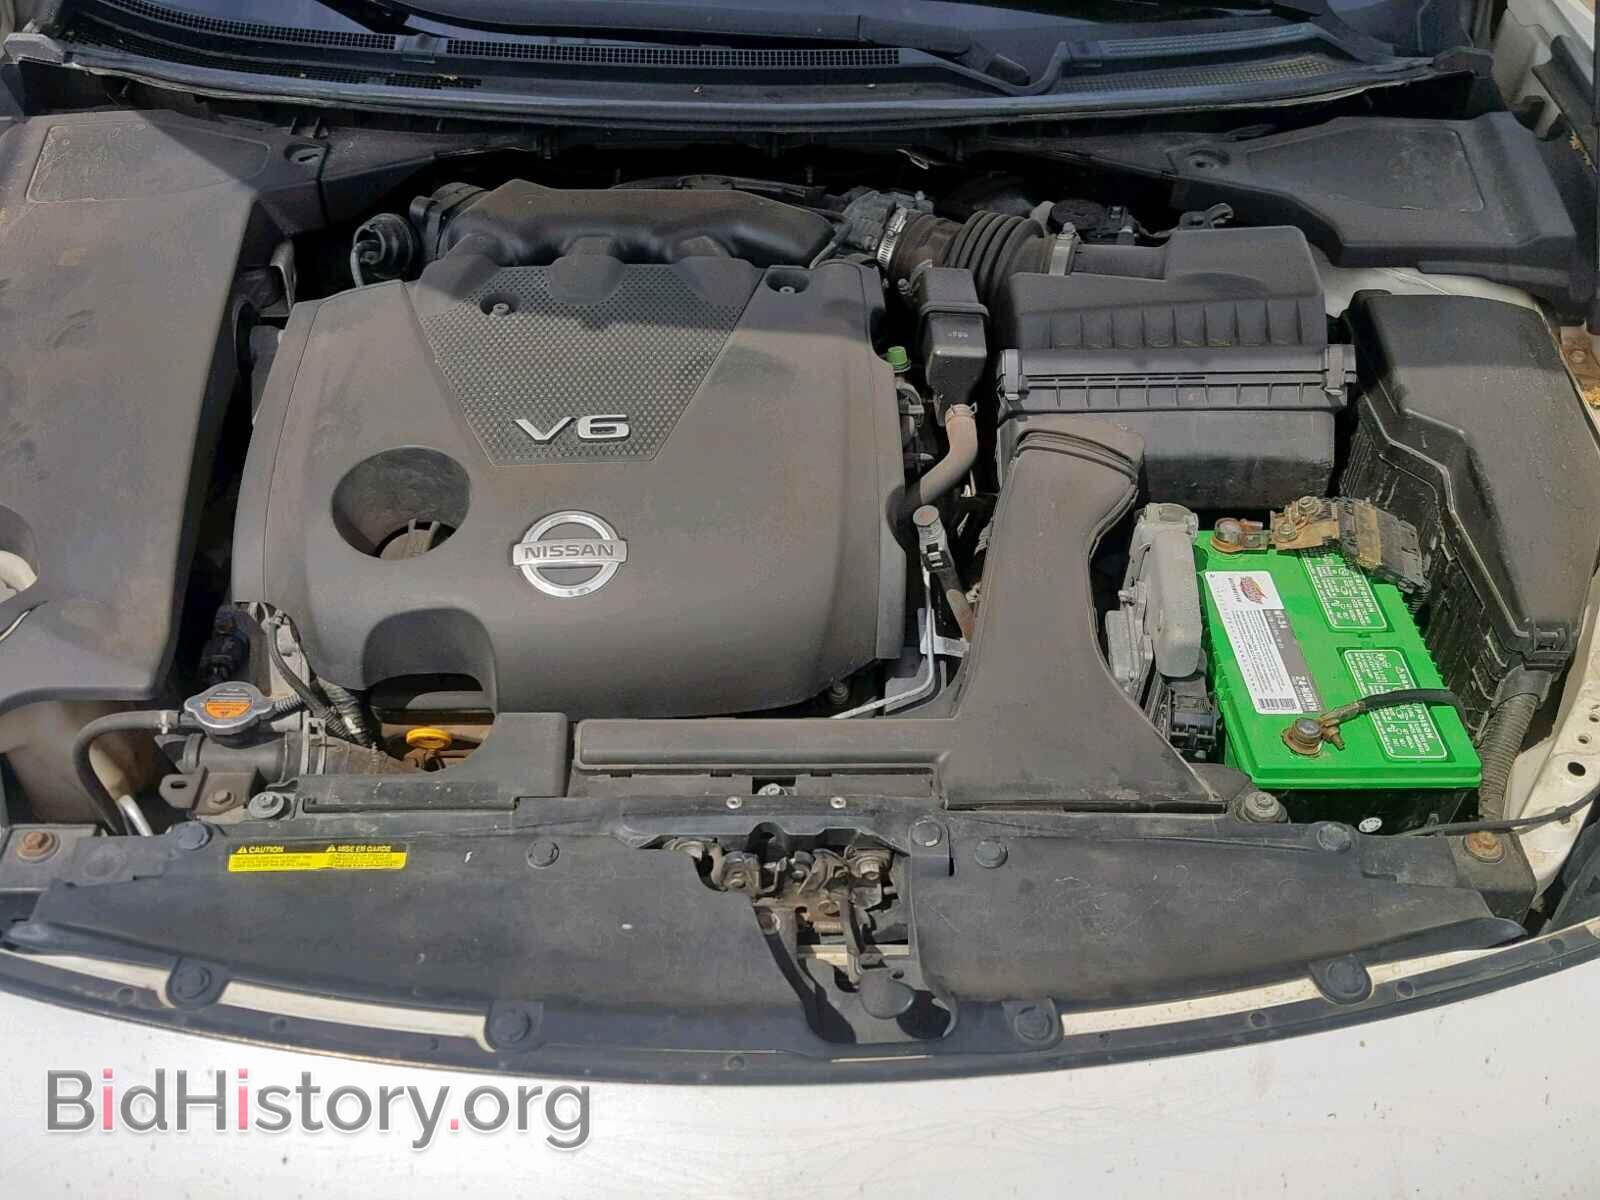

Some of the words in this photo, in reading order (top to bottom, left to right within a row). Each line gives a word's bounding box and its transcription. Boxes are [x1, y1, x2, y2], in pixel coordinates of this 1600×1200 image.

[513, 414, 631, 442] V6
[524, 544, 614, 560] NISSAN
[248, 845, 285, 854] CAUTION
